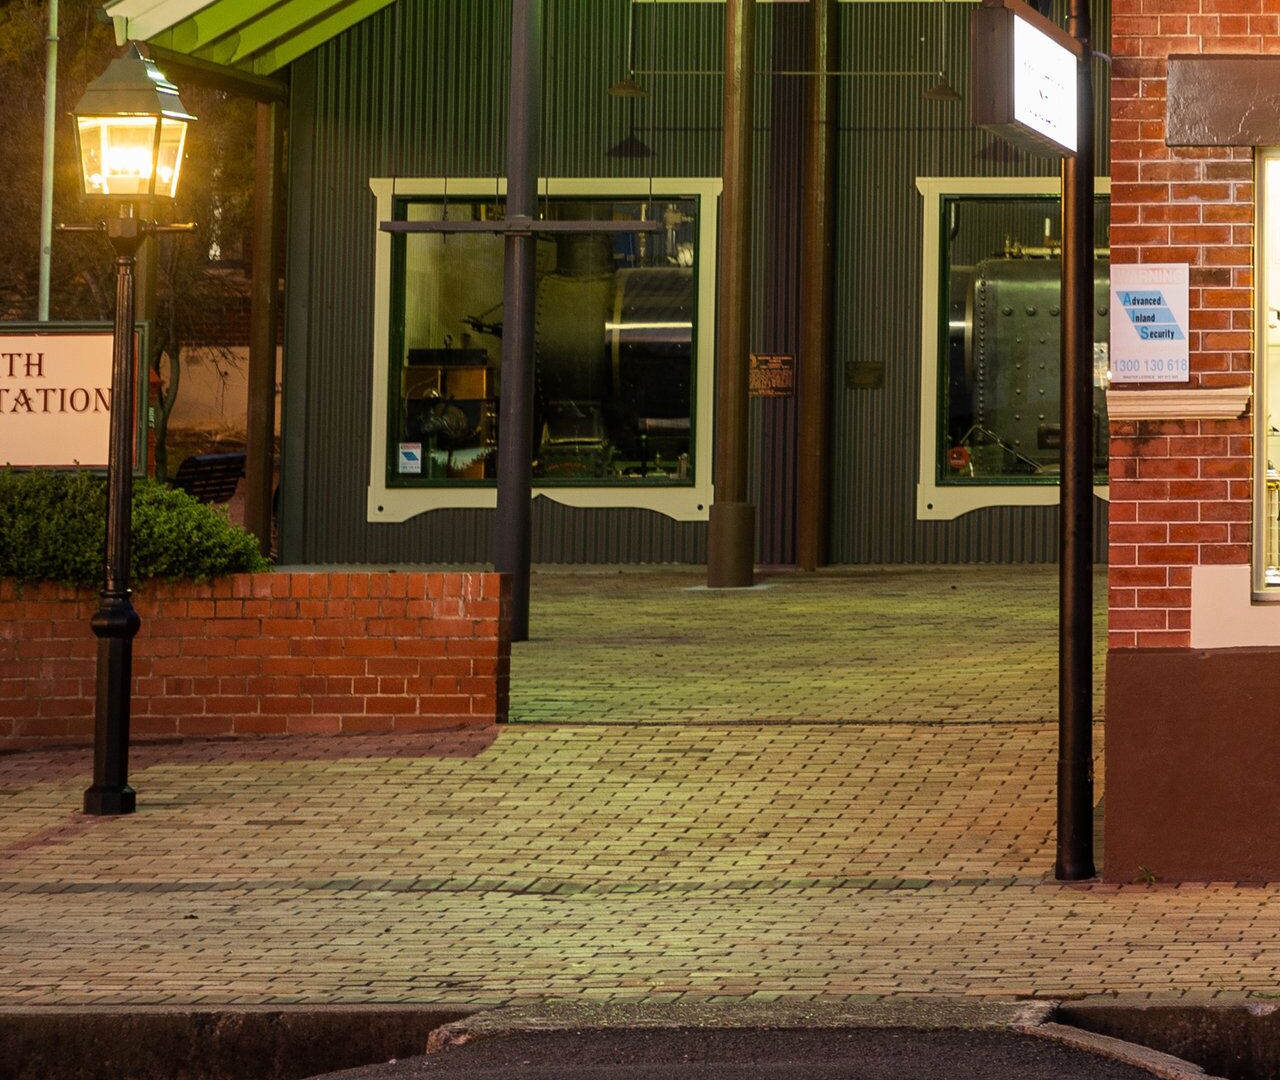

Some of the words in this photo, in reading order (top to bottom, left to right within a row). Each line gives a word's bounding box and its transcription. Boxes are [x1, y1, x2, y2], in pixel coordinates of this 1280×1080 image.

[1123, 292, 1161, 306] Advanced
[1132, 309, 1155, 323] Inland
[1140, 326, 1175, 340] Security
[1113, 359, 1140, 372] 1300
[1144, 359, 1164, 372] 130
[1167, 358, 1187, 372] 618
